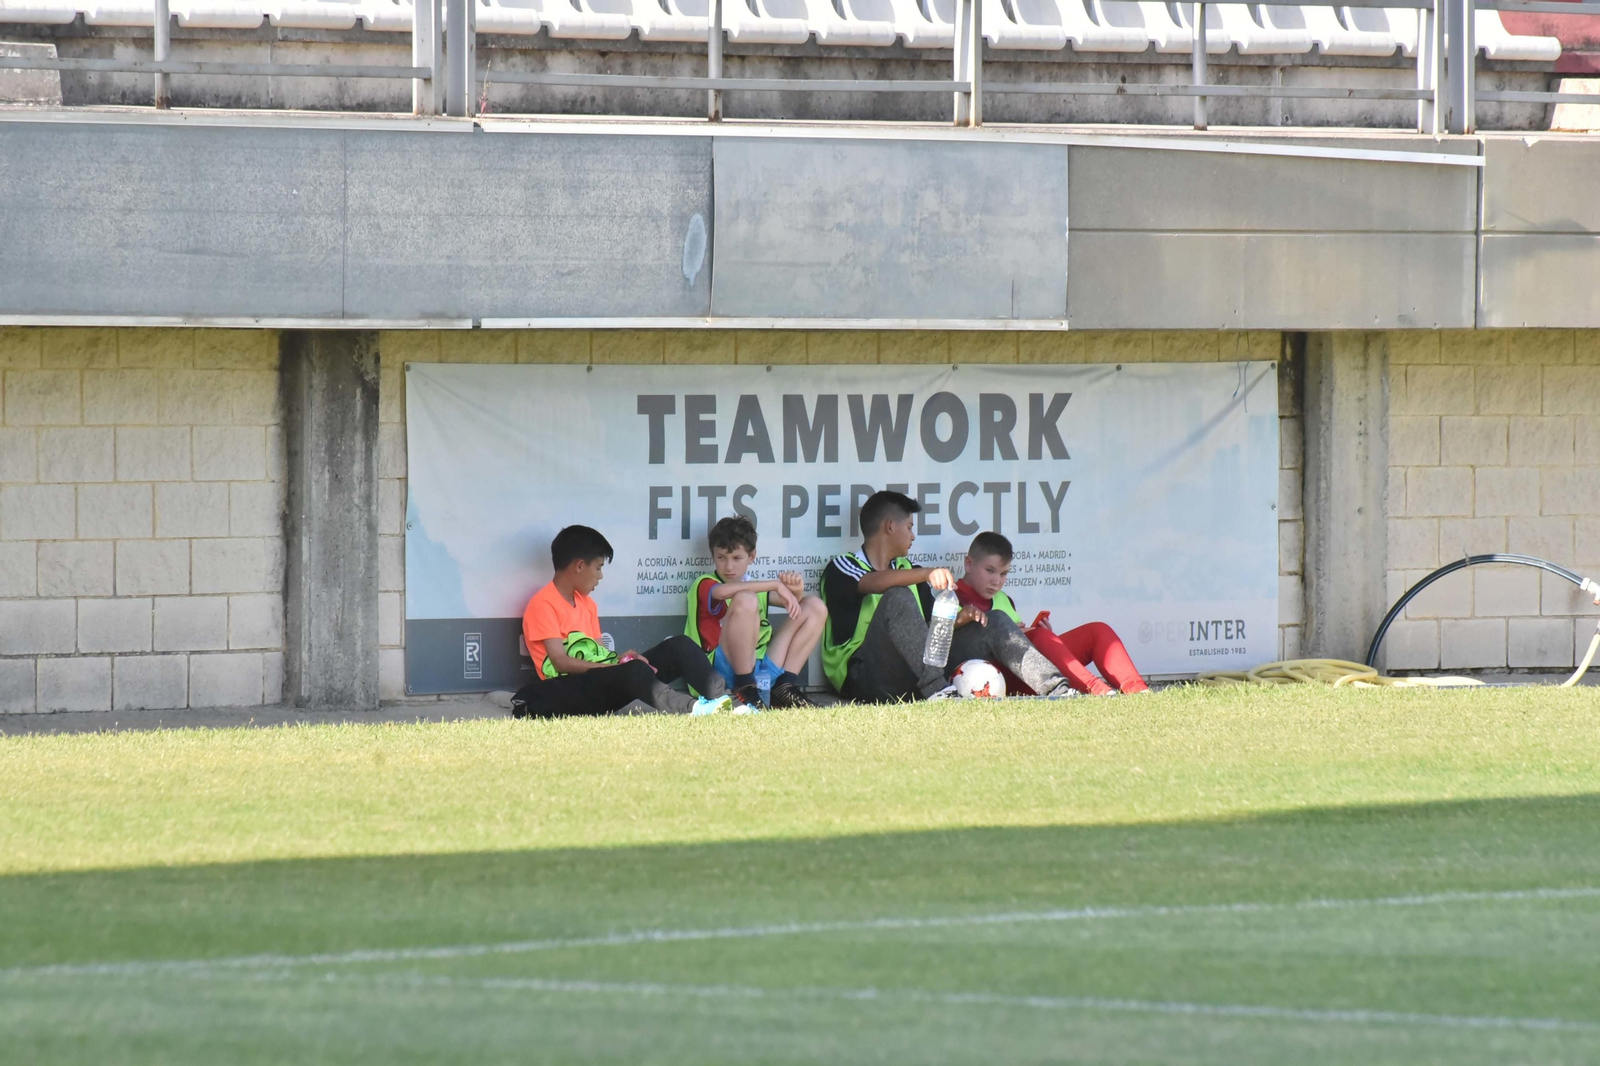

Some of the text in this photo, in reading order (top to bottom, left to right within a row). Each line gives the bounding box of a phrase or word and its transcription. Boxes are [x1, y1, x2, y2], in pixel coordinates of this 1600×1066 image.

[637, 391, 1073, 464] TEAMWORK
[649, 481, 1071, 540] FITS PERECTLY
[637, 557, 643, 567] A
[644, 555, 677, 567] CORUÑA
[685, 557, 714, 567] ALGECI
[778, 555, 822, 565] BARCELONA
[907, 553, 938, 562] TAGENA
[1012, 551, 1031, 560] DOBA
[1038, 550, 1067, 560] MADRID
[637, 570, 668, 580] MÁLAGA
[1025, 564, 1034, 573] LA
[1036, 563, 1066, 573] HABANA
[636, 576, 1072, 595] LIMA LISBOA SHENZEN XIAMEN
[1189, 647, 1246, 656] ESTABLISHED 1983
